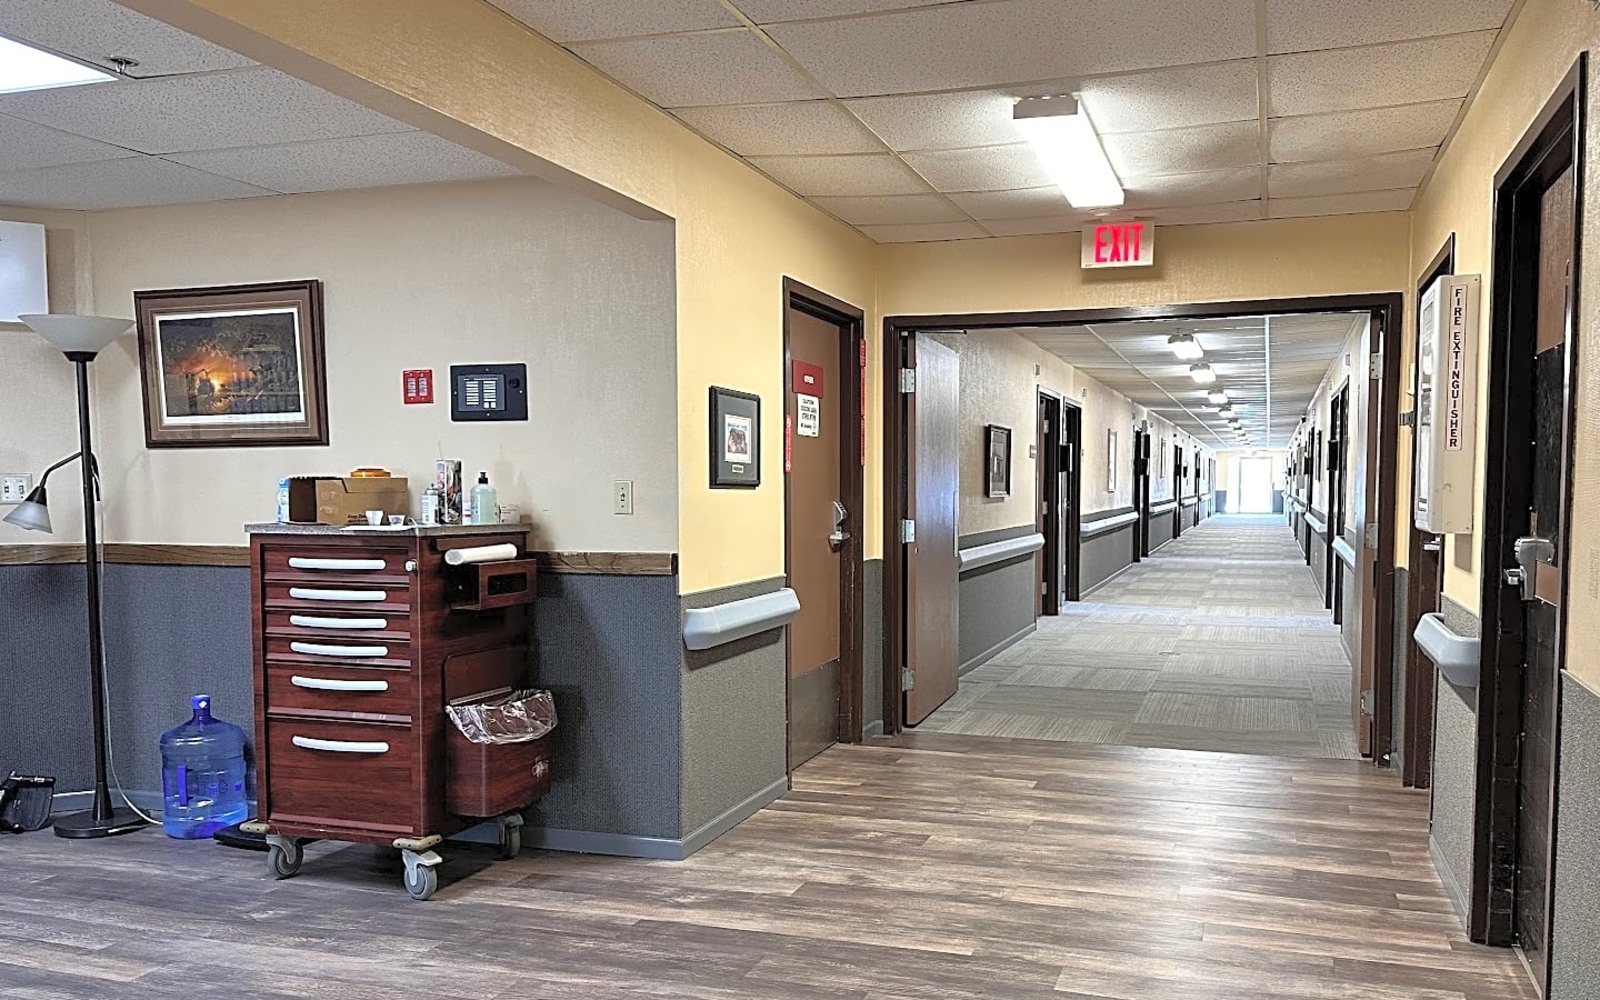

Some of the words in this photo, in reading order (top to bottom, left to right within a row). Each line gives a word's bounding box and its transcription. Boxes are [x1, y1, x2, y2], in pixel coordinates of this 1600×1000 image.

[1095, 223, 1144, 262] EXIT
[1454, 288, 1463, 326] FIRE
[1449, 332, 1461, 447] EXTINGUISHER
